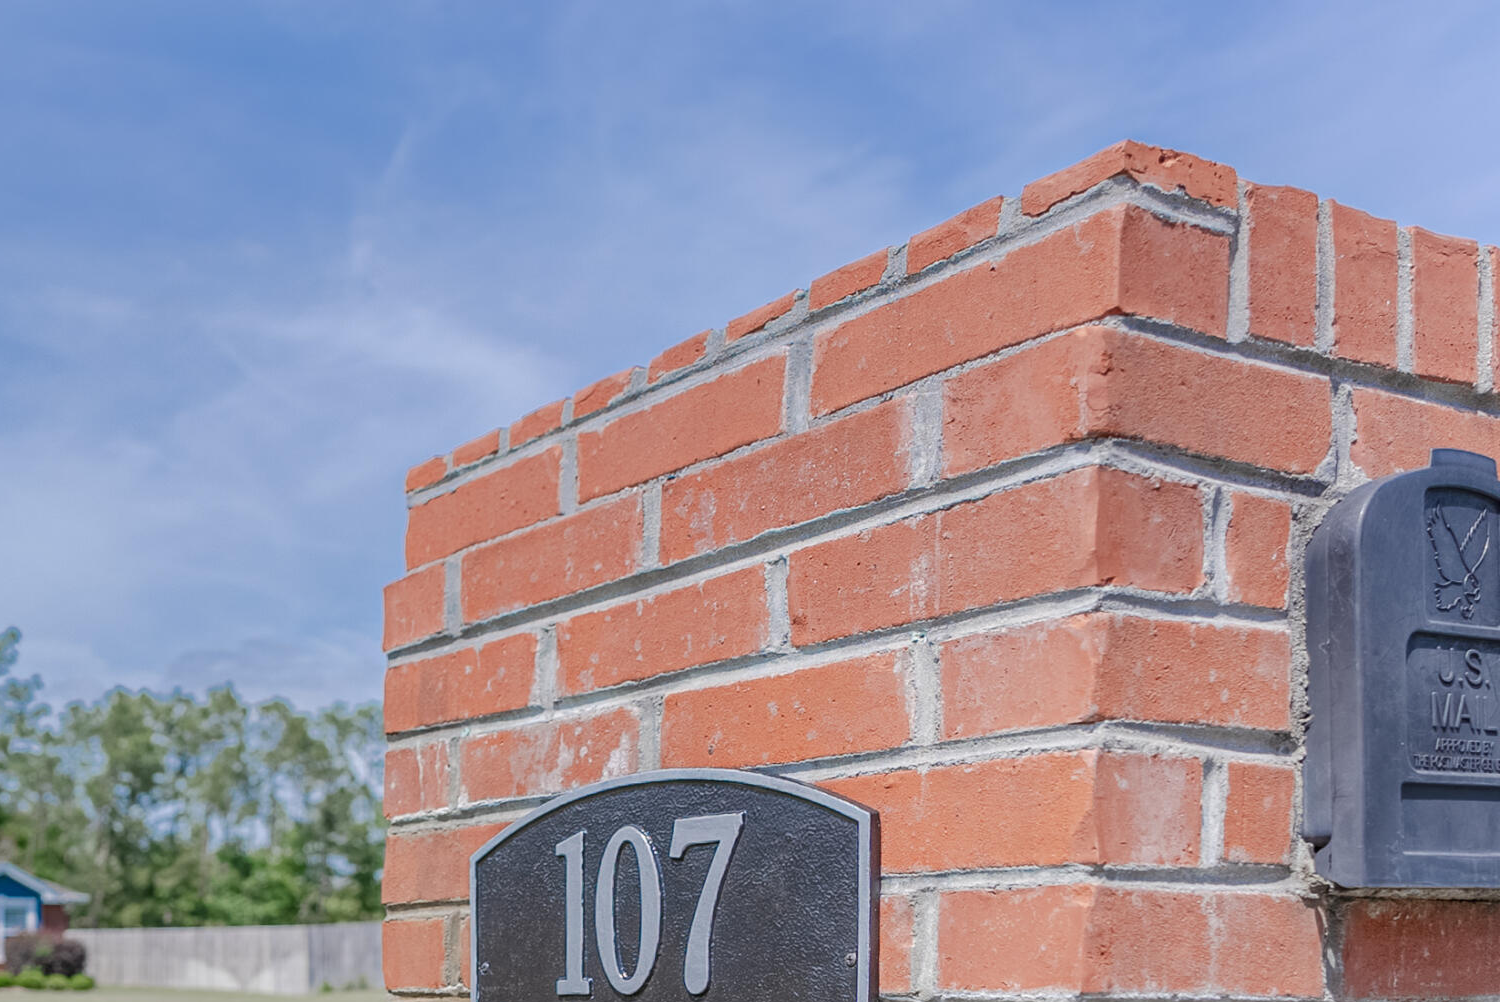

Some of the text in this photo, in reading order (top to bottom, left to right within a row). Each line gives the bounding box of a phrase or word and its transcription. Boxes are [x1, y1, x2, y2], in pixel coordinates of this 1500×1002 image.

[1436, 646, 1491, 690] U.S.
[1430, 691, 1498, 736] MAIL
[555, 810, 747, 997] 107
